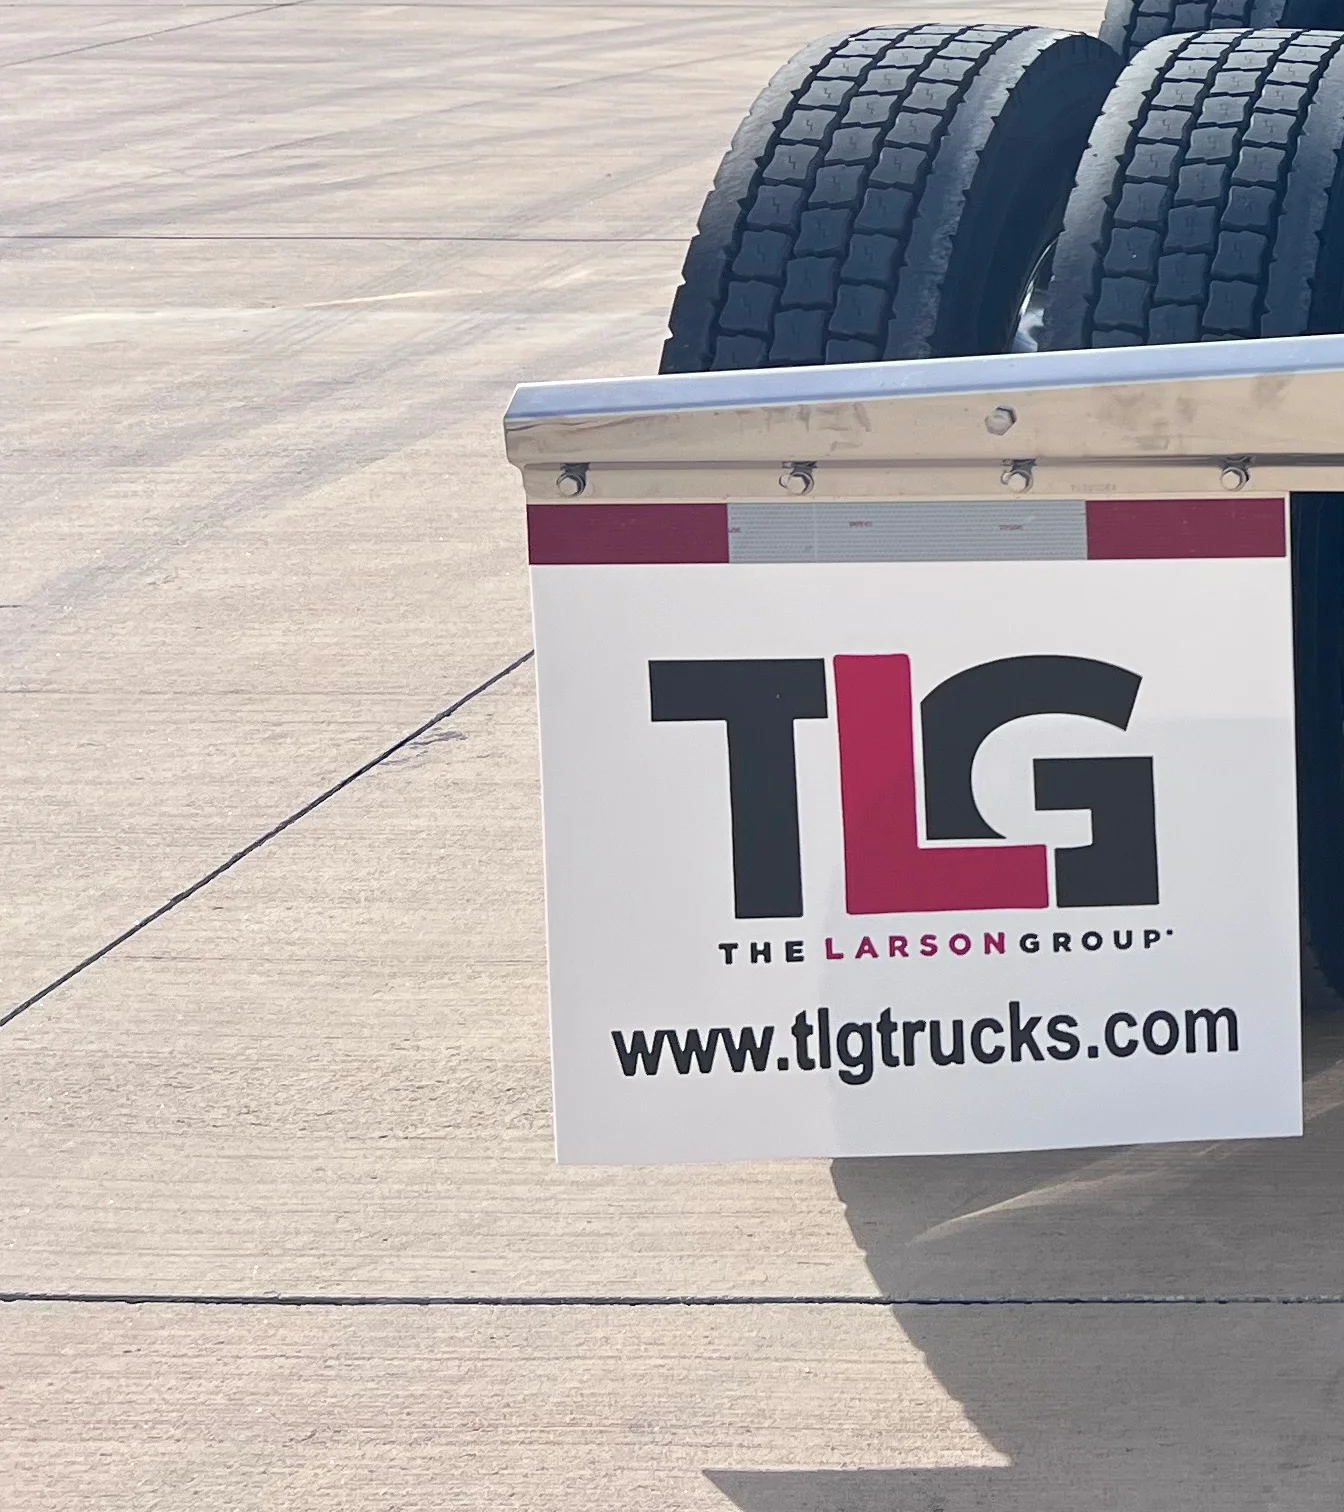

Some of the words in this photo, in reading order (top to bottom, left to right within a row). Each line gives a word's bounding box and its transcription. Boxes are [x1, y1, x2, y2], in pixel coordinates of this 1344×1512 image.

[648, 654, 1159, 919] TLG
[719, 941, 805, 965] THE
[611, 1000, 1239, 1086] www.tlgtrucks.com
